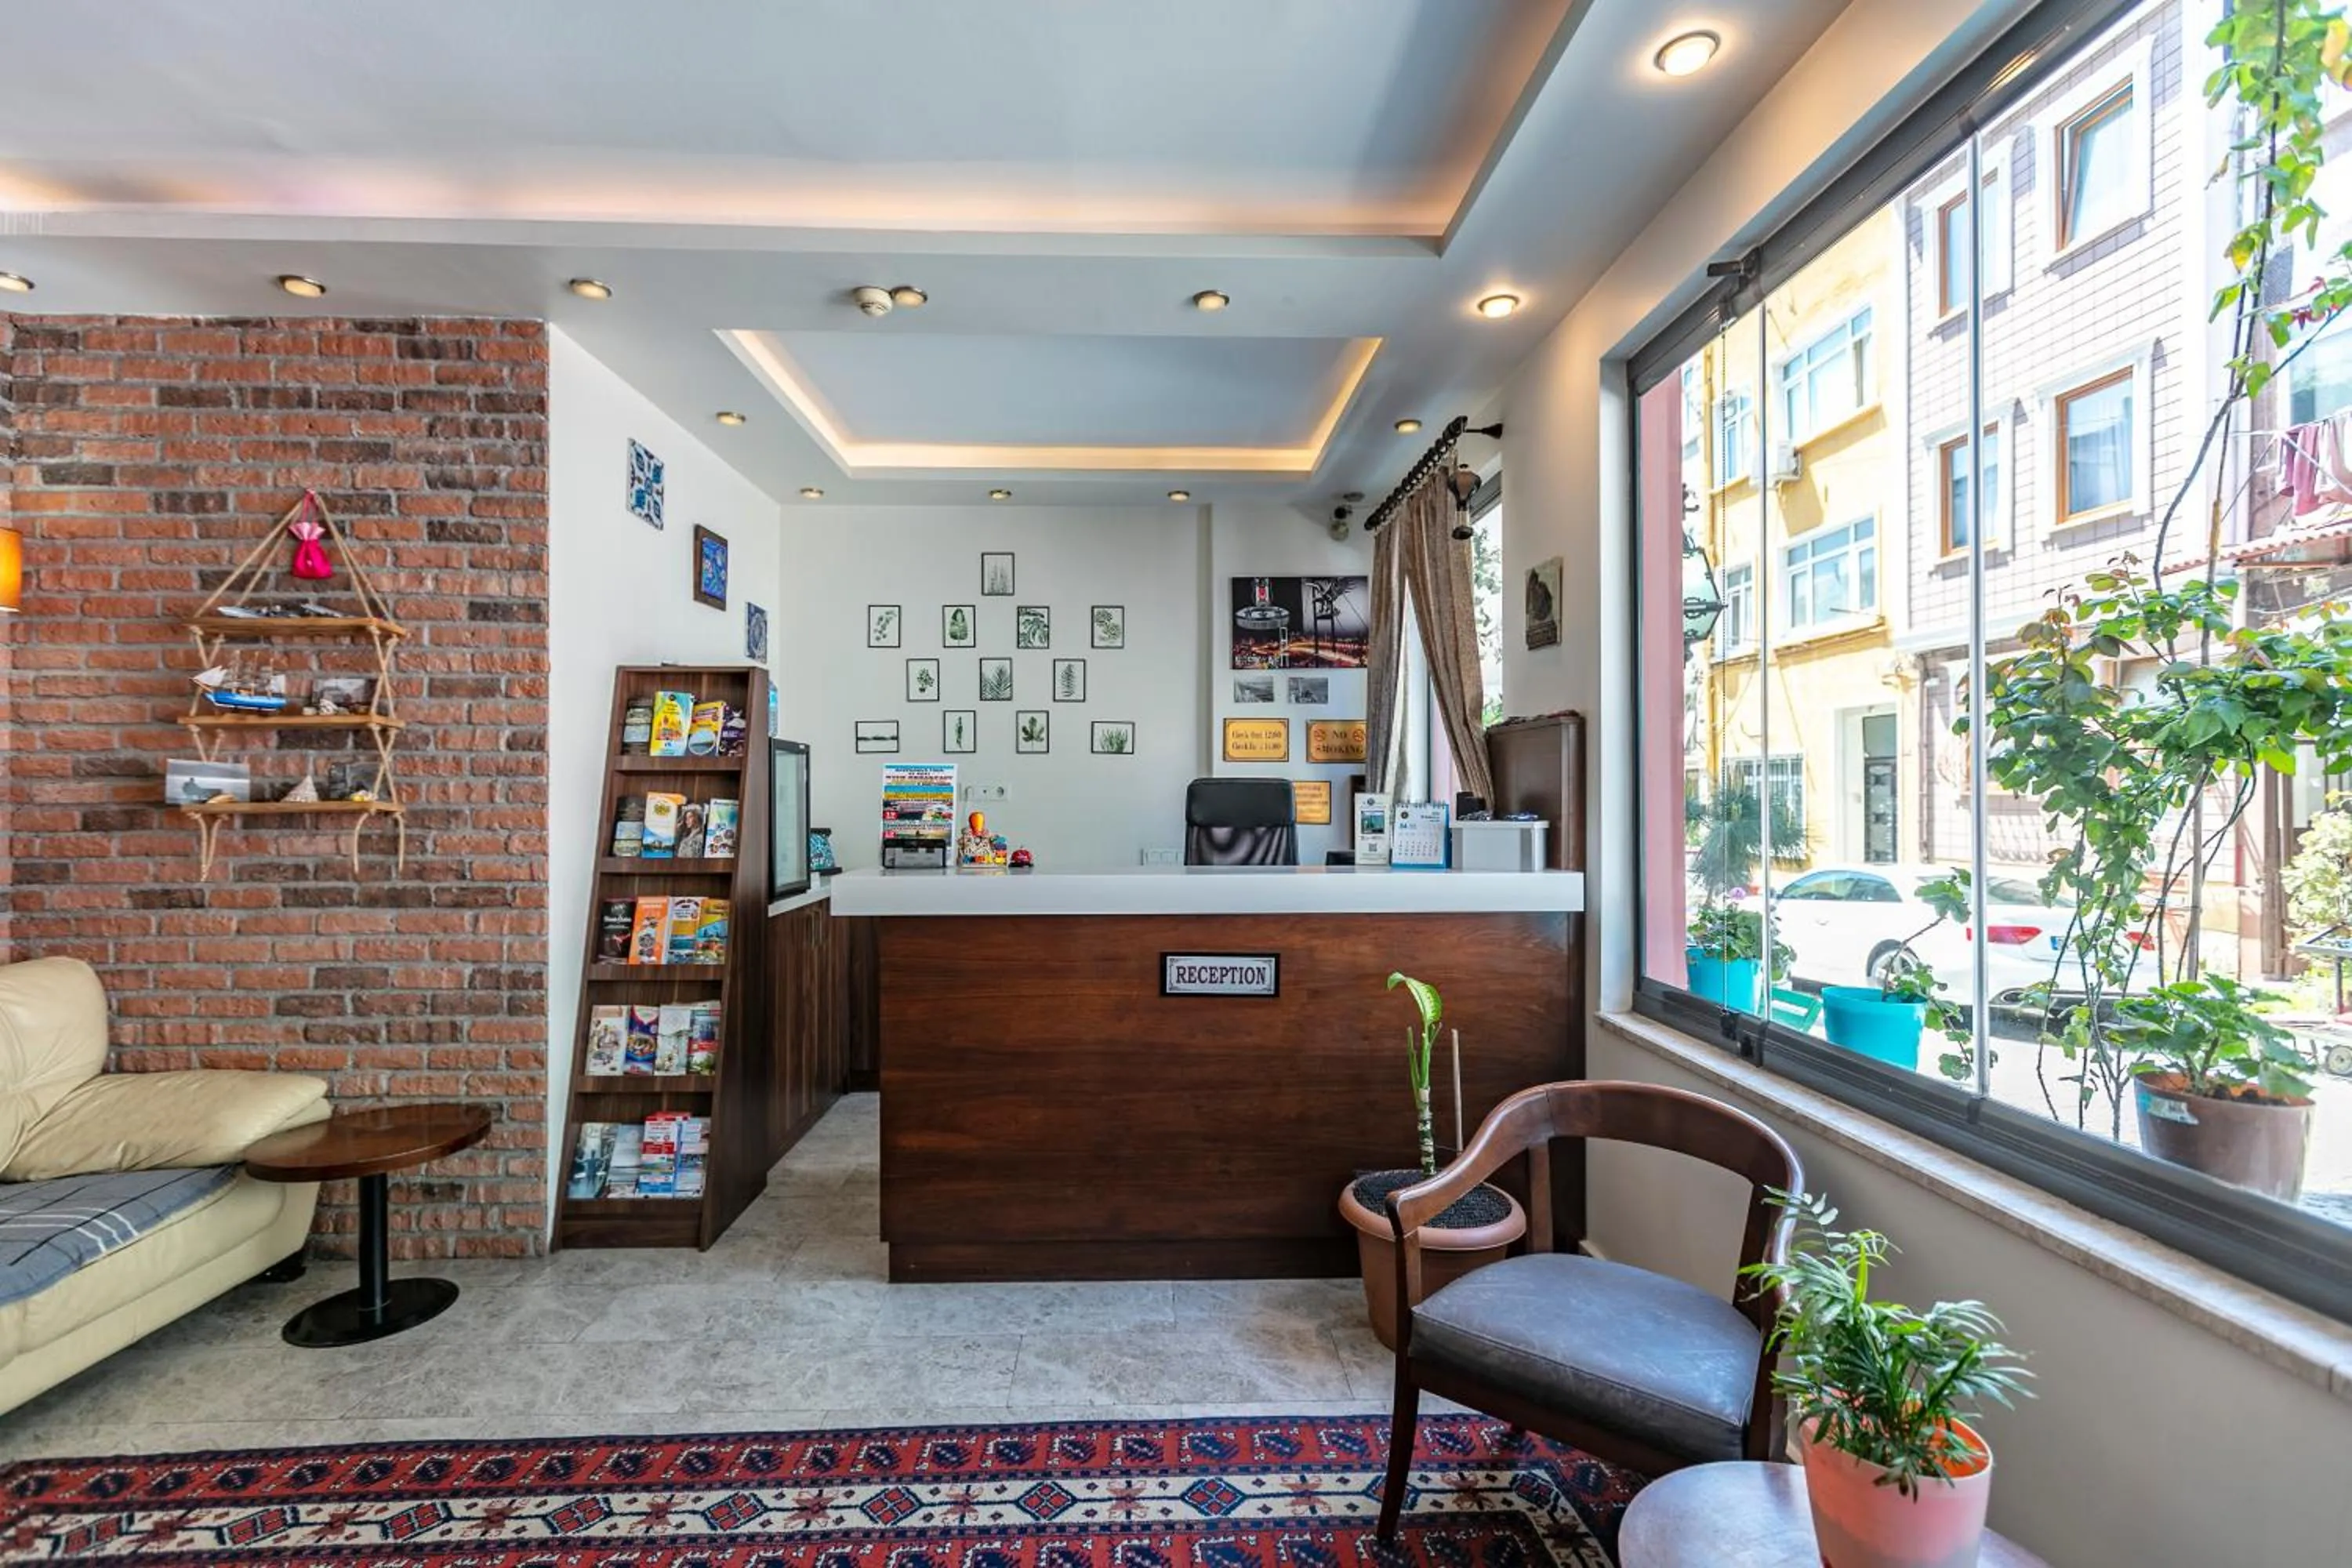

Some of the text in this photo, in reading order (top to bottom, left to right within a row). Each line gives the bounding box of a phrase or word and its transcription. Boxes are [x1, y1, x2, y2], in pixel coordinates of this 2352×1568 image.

[1332, 730, 1348, 739] NO
[1316, 744, 1363, 753] SMOKING
[1175, 965, 1266, 985] RECEPTION
